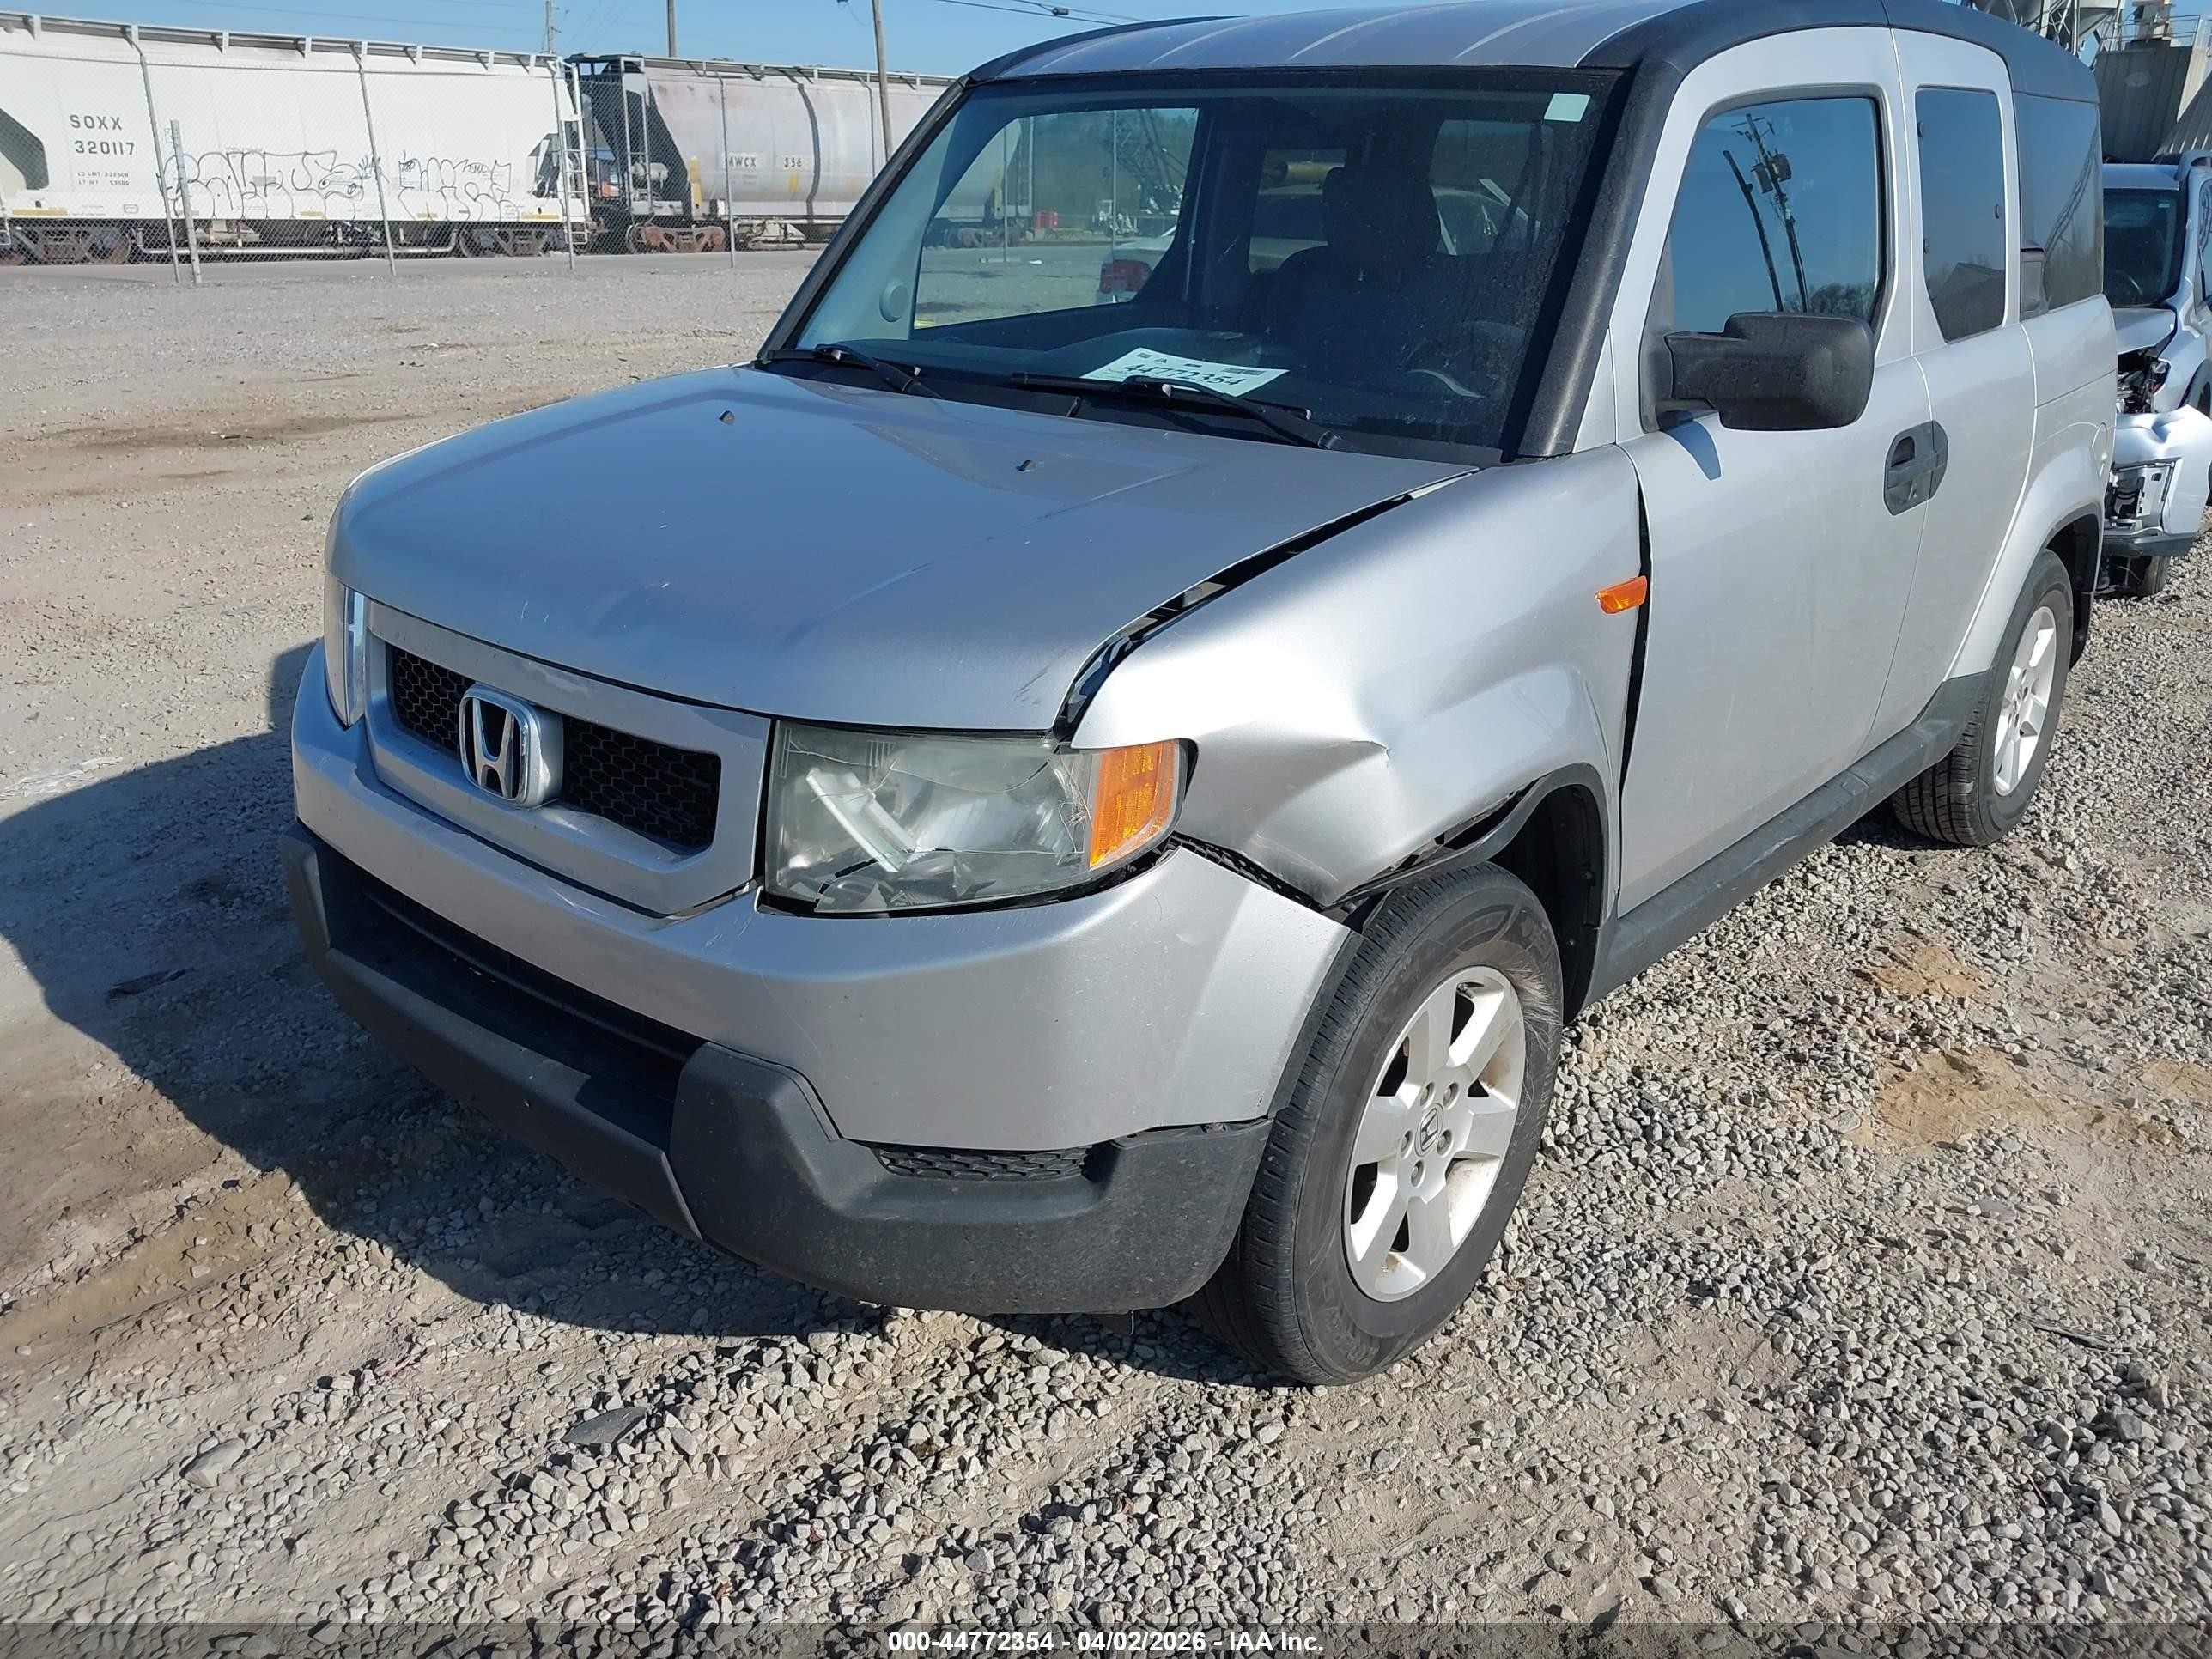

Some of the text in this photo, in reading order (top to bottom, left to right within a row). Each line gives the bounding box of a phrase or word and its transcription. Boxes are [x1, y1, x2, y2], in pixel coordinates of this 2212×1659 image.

[70, 114, 122, 130] SOXX
[75, 140, 134, 155] 320117
[1123, 363, 1246, 386] 44772354
